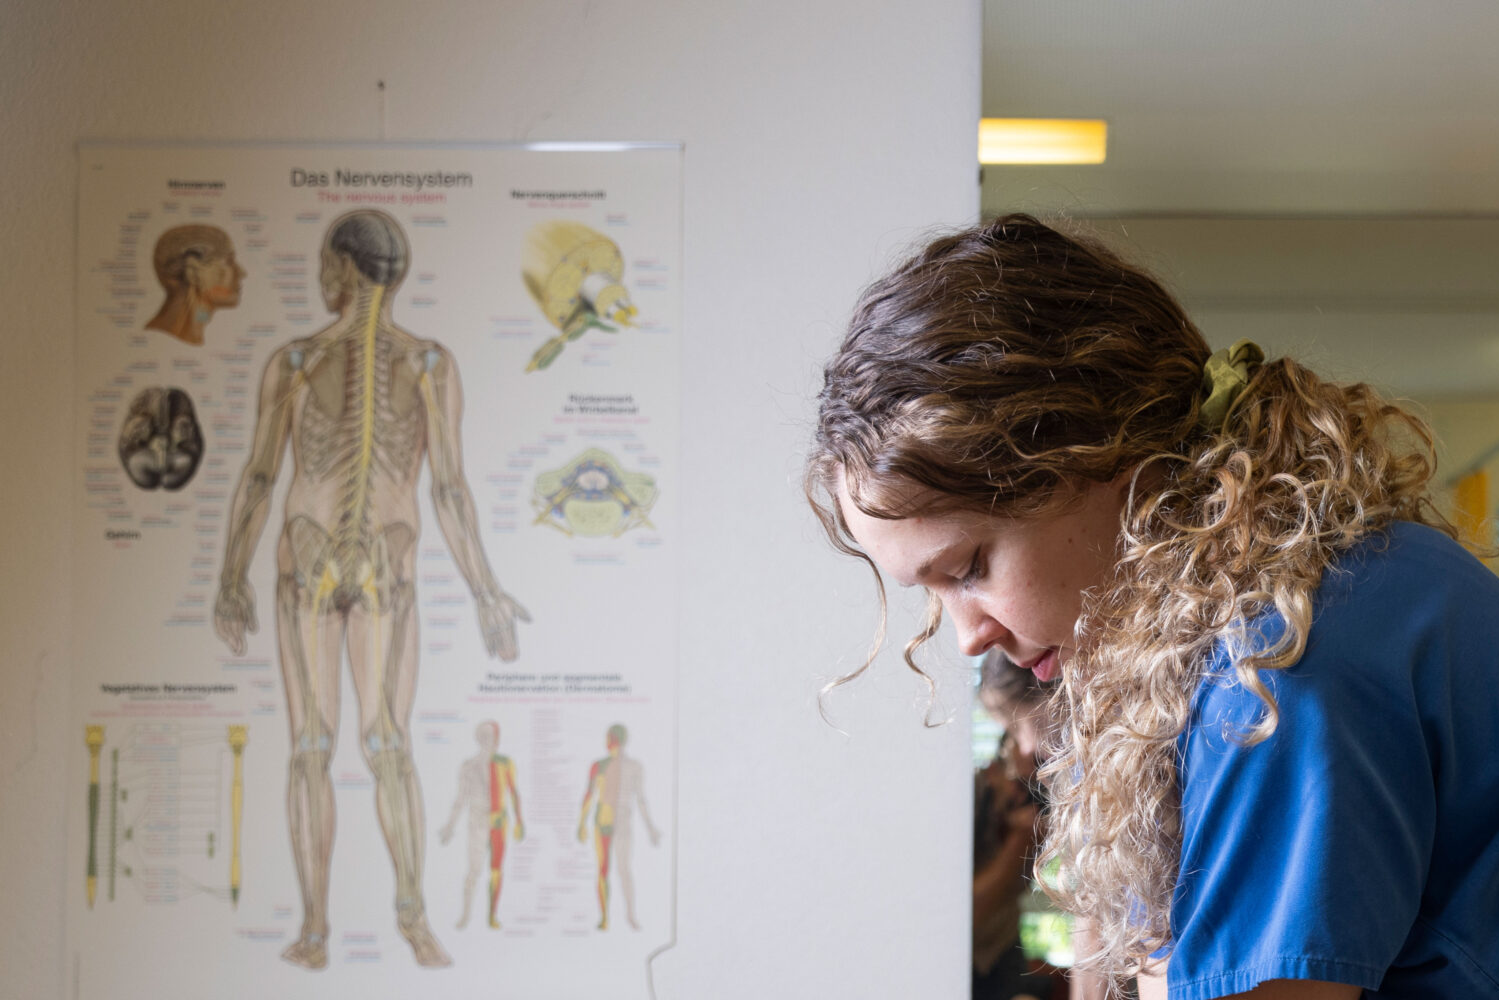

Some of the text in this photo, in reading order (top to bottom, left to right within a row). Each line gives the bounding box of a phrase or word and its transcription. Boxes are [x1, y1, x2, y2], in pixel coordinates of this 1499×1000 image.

[290, 168, 474, 192] Das Nervensystem
[317, 191, 342, 203] The
